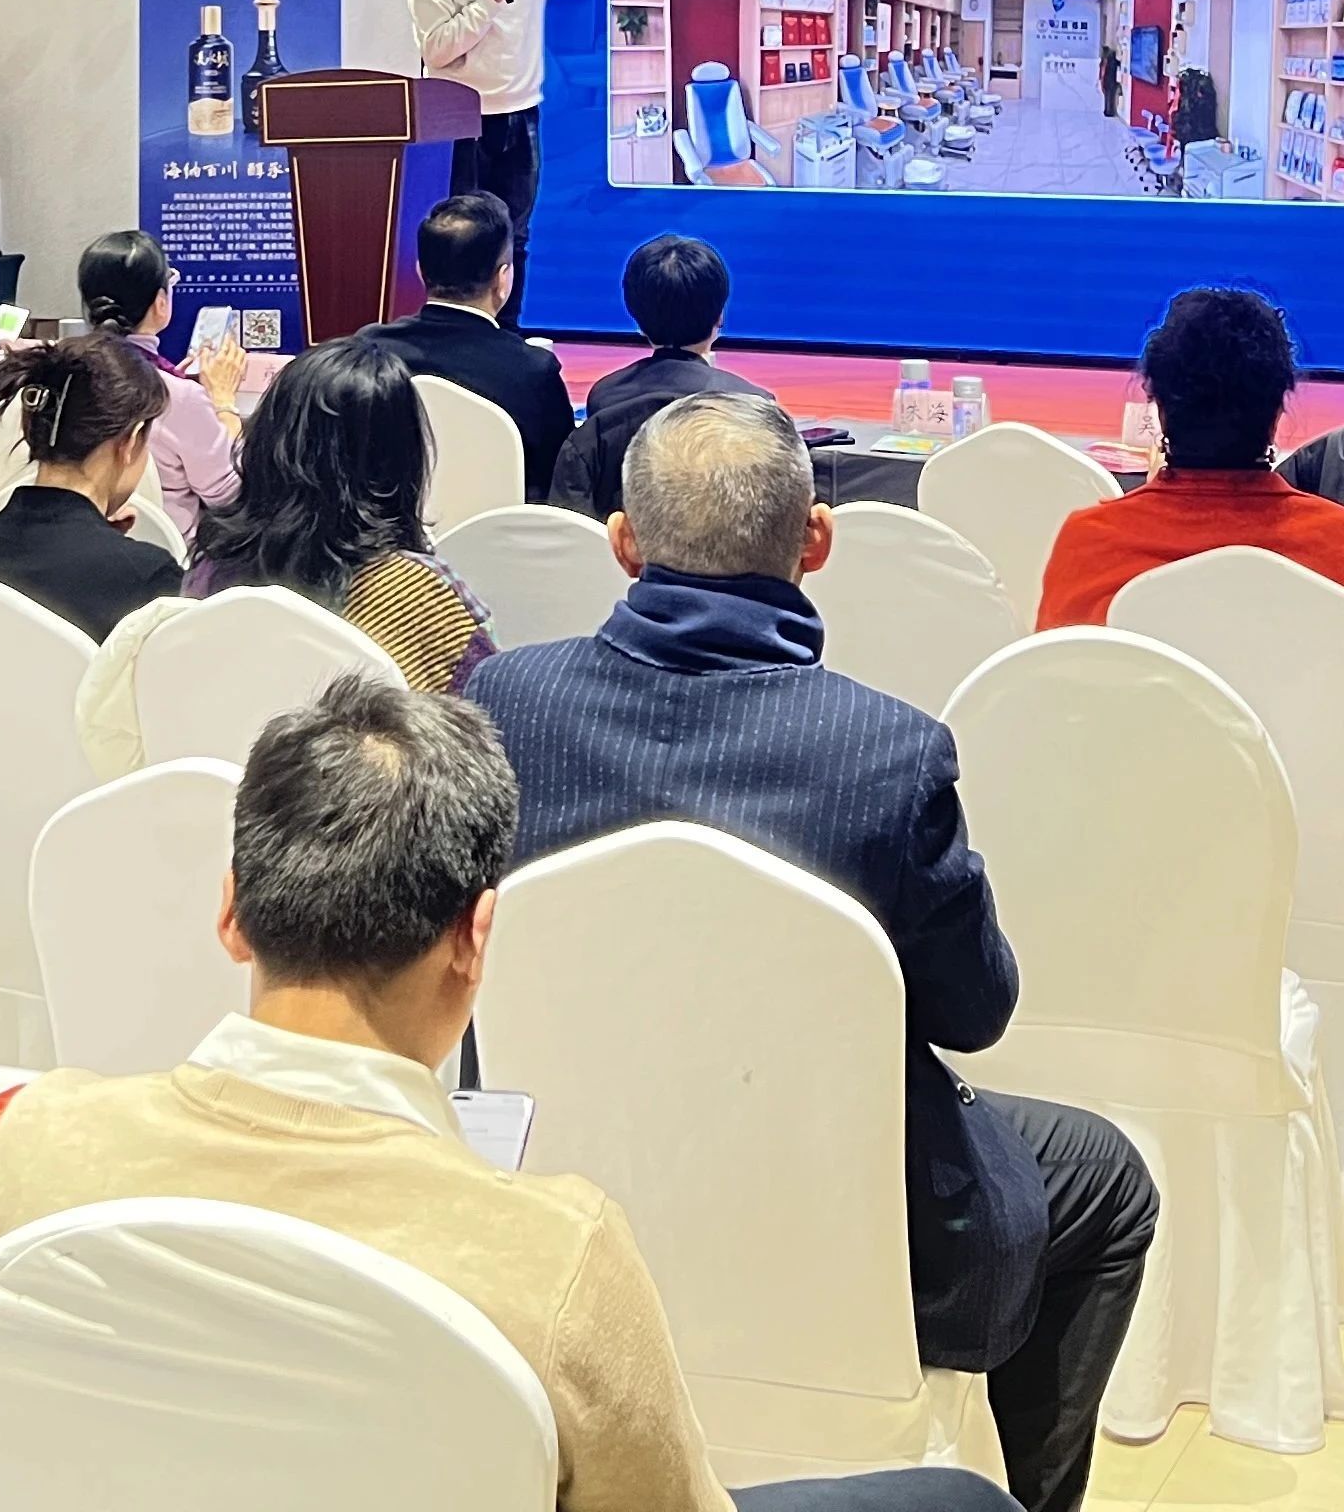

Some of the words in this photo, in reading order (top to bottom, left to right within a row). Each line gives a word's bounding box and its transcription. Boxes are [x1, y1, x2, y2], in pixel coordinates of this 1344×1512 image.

[163, 160, 238, 180] 海纳百川
[247, 161, 290, 179] 醇承
